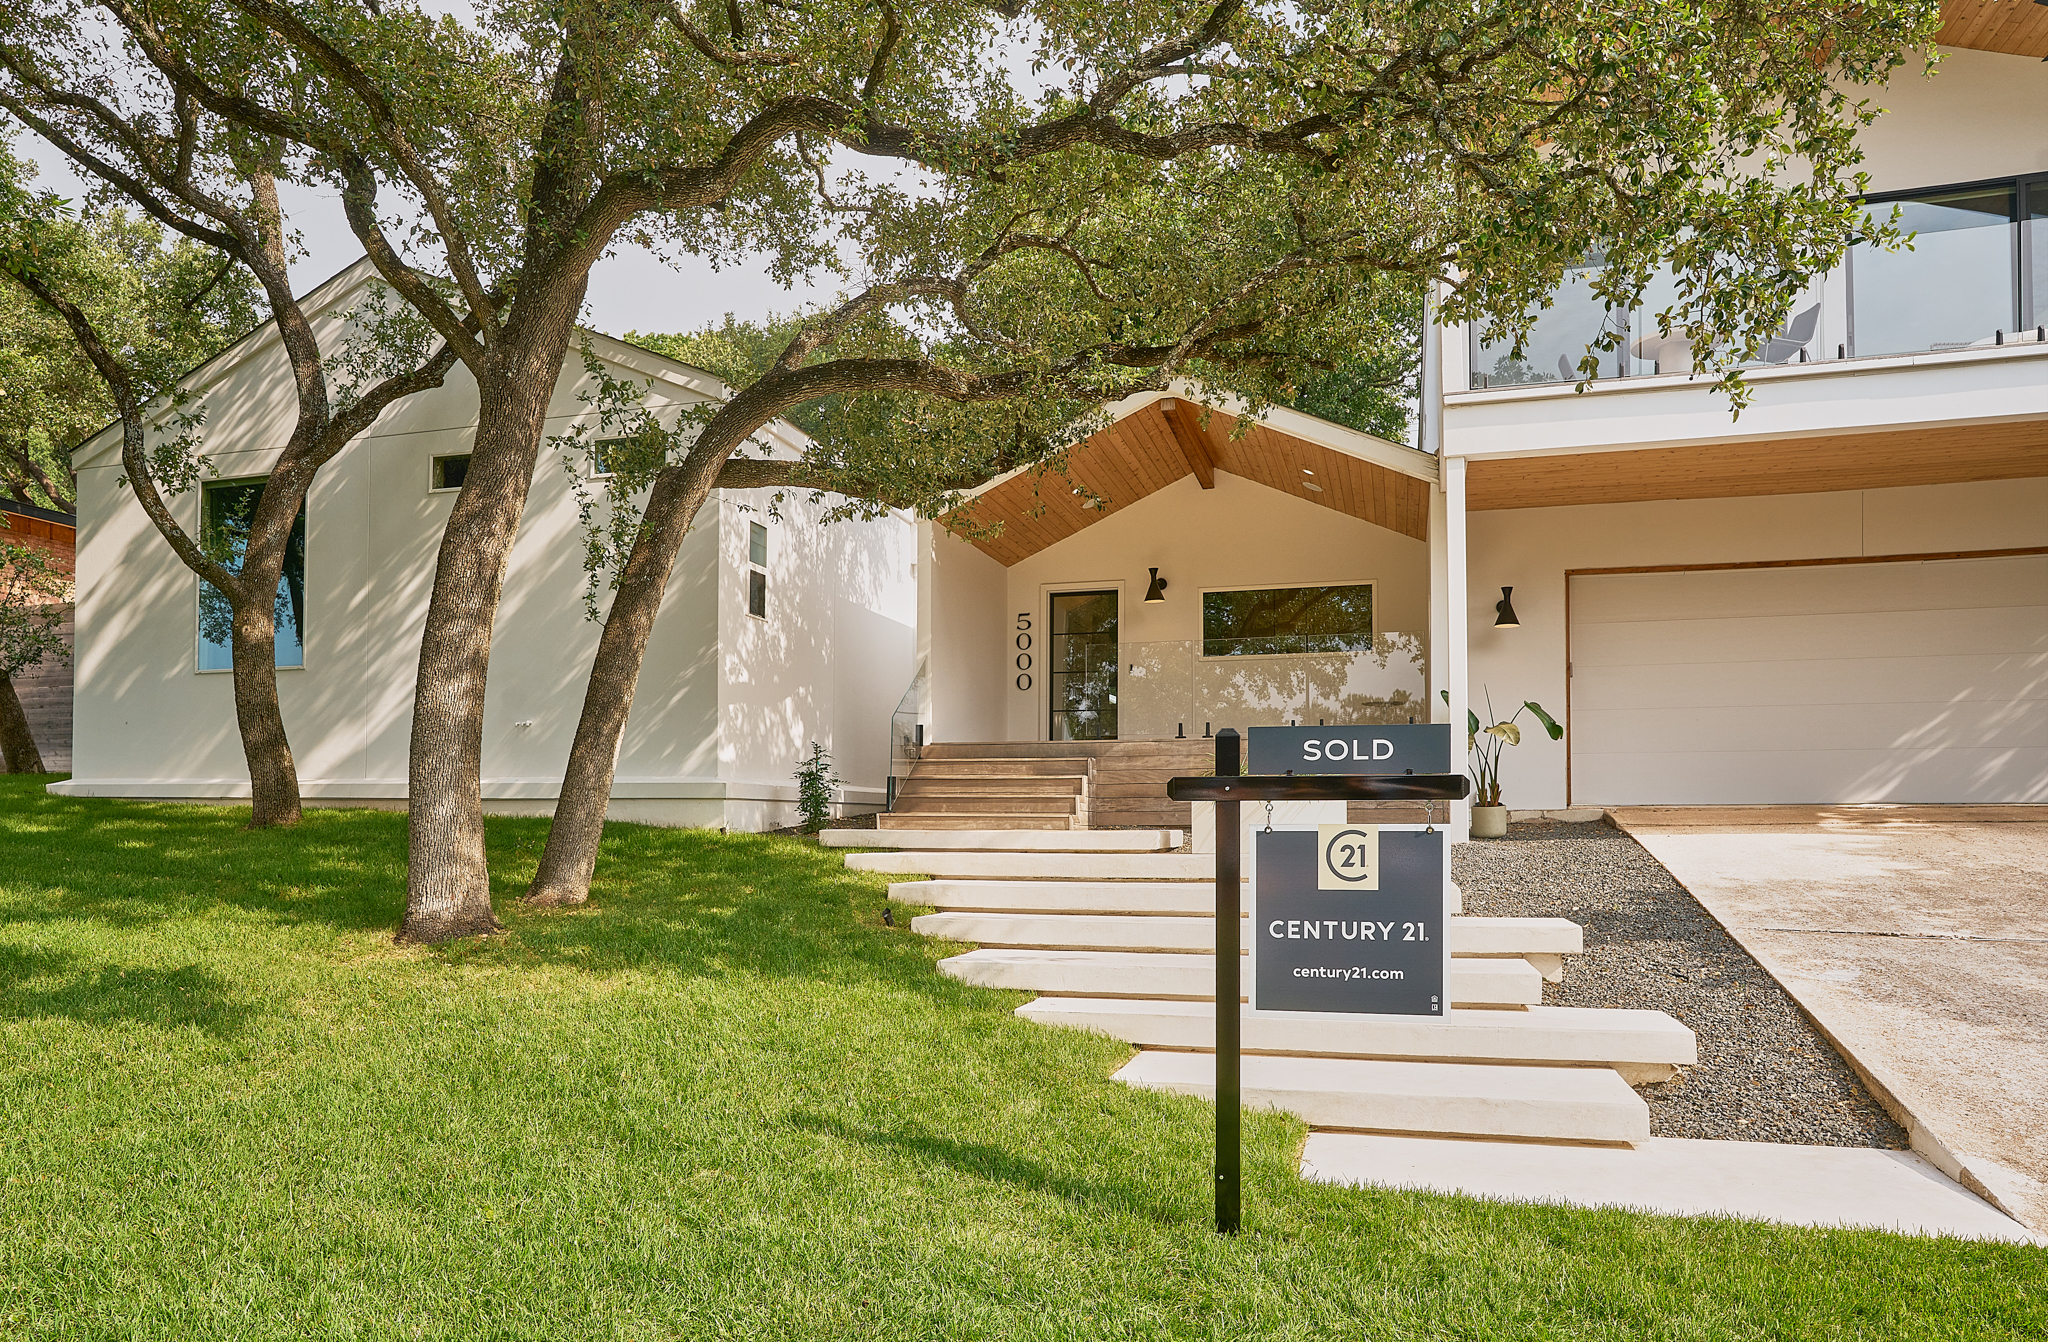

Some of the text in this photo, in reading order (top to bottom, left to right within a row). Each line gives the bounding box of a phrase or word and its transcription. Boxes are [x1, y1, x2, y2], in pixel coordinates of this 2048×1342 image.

[1016, 612, 1032, 691] 5000
[1302, 739, 1395, 761] SOLD
[1268, 920, 1396, 941] CENTURY
[1292, 966, 1404, 981] century21.com
